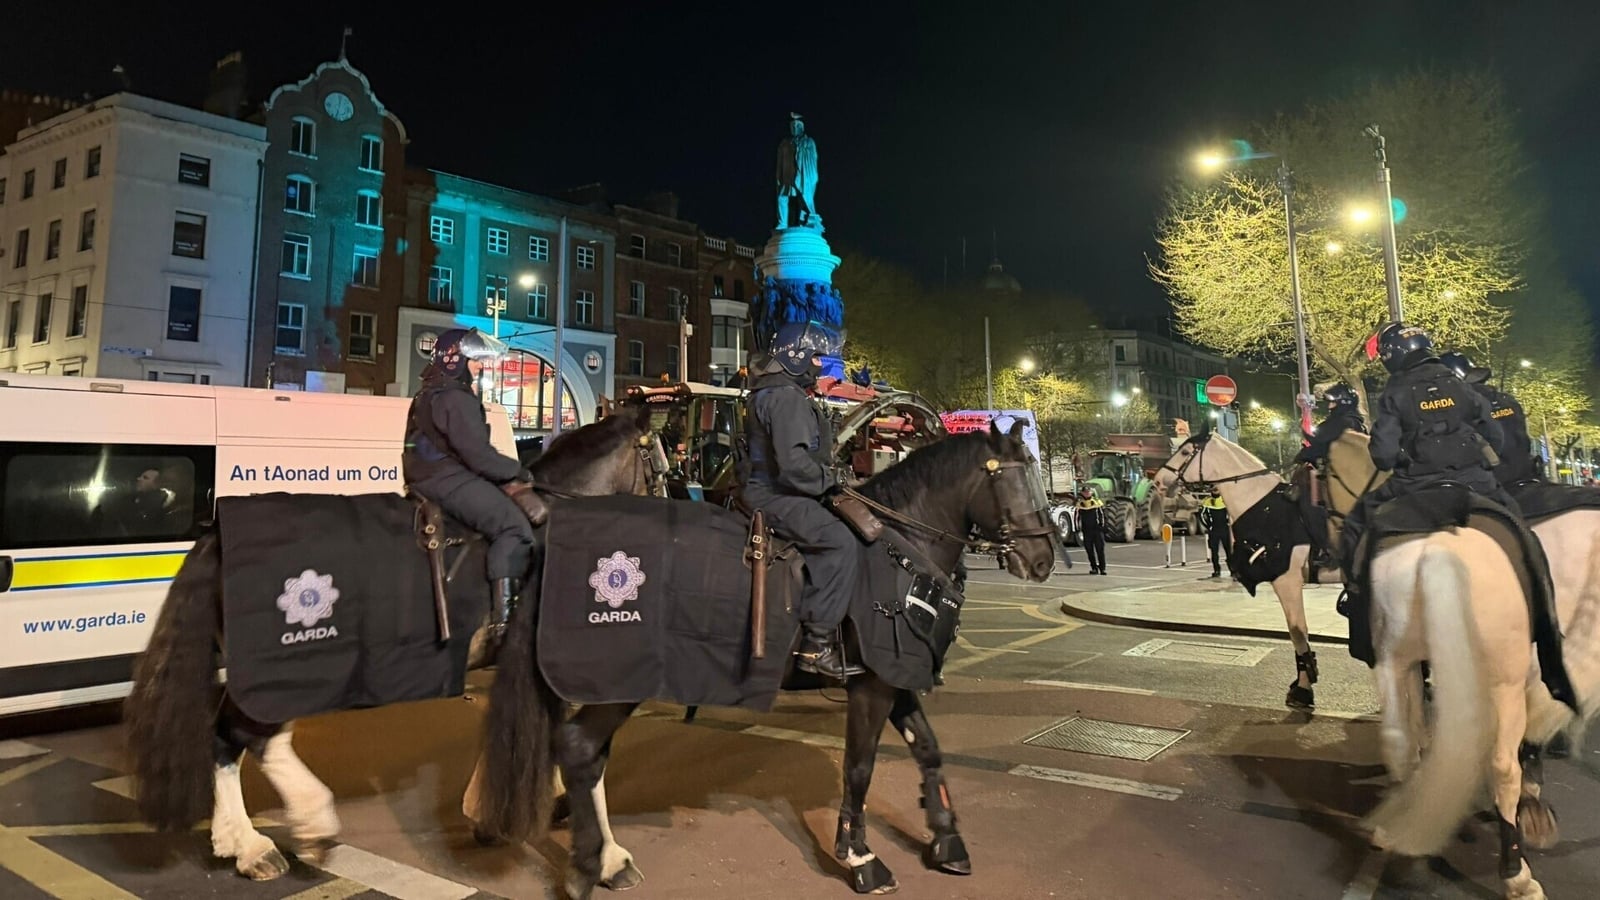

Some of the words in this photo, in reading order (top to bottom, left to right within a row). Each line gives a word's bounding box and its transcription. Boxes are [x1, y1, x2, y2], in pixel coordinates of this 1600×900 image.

[1420, 398, 1455, 410] GARDA
[1490, 408, 1514, 419] GARDA
[230, 465, 256, 481] An
[264, 465, 329, 481] tAonad
[336, 469, 361, 481] um
[368, 466, 398, 481] Ord
[24, 610, 146, 633] www.garda.ie
[588, 610, 642, 624] GARDA
[281, 625, 338, 645] GARDA
